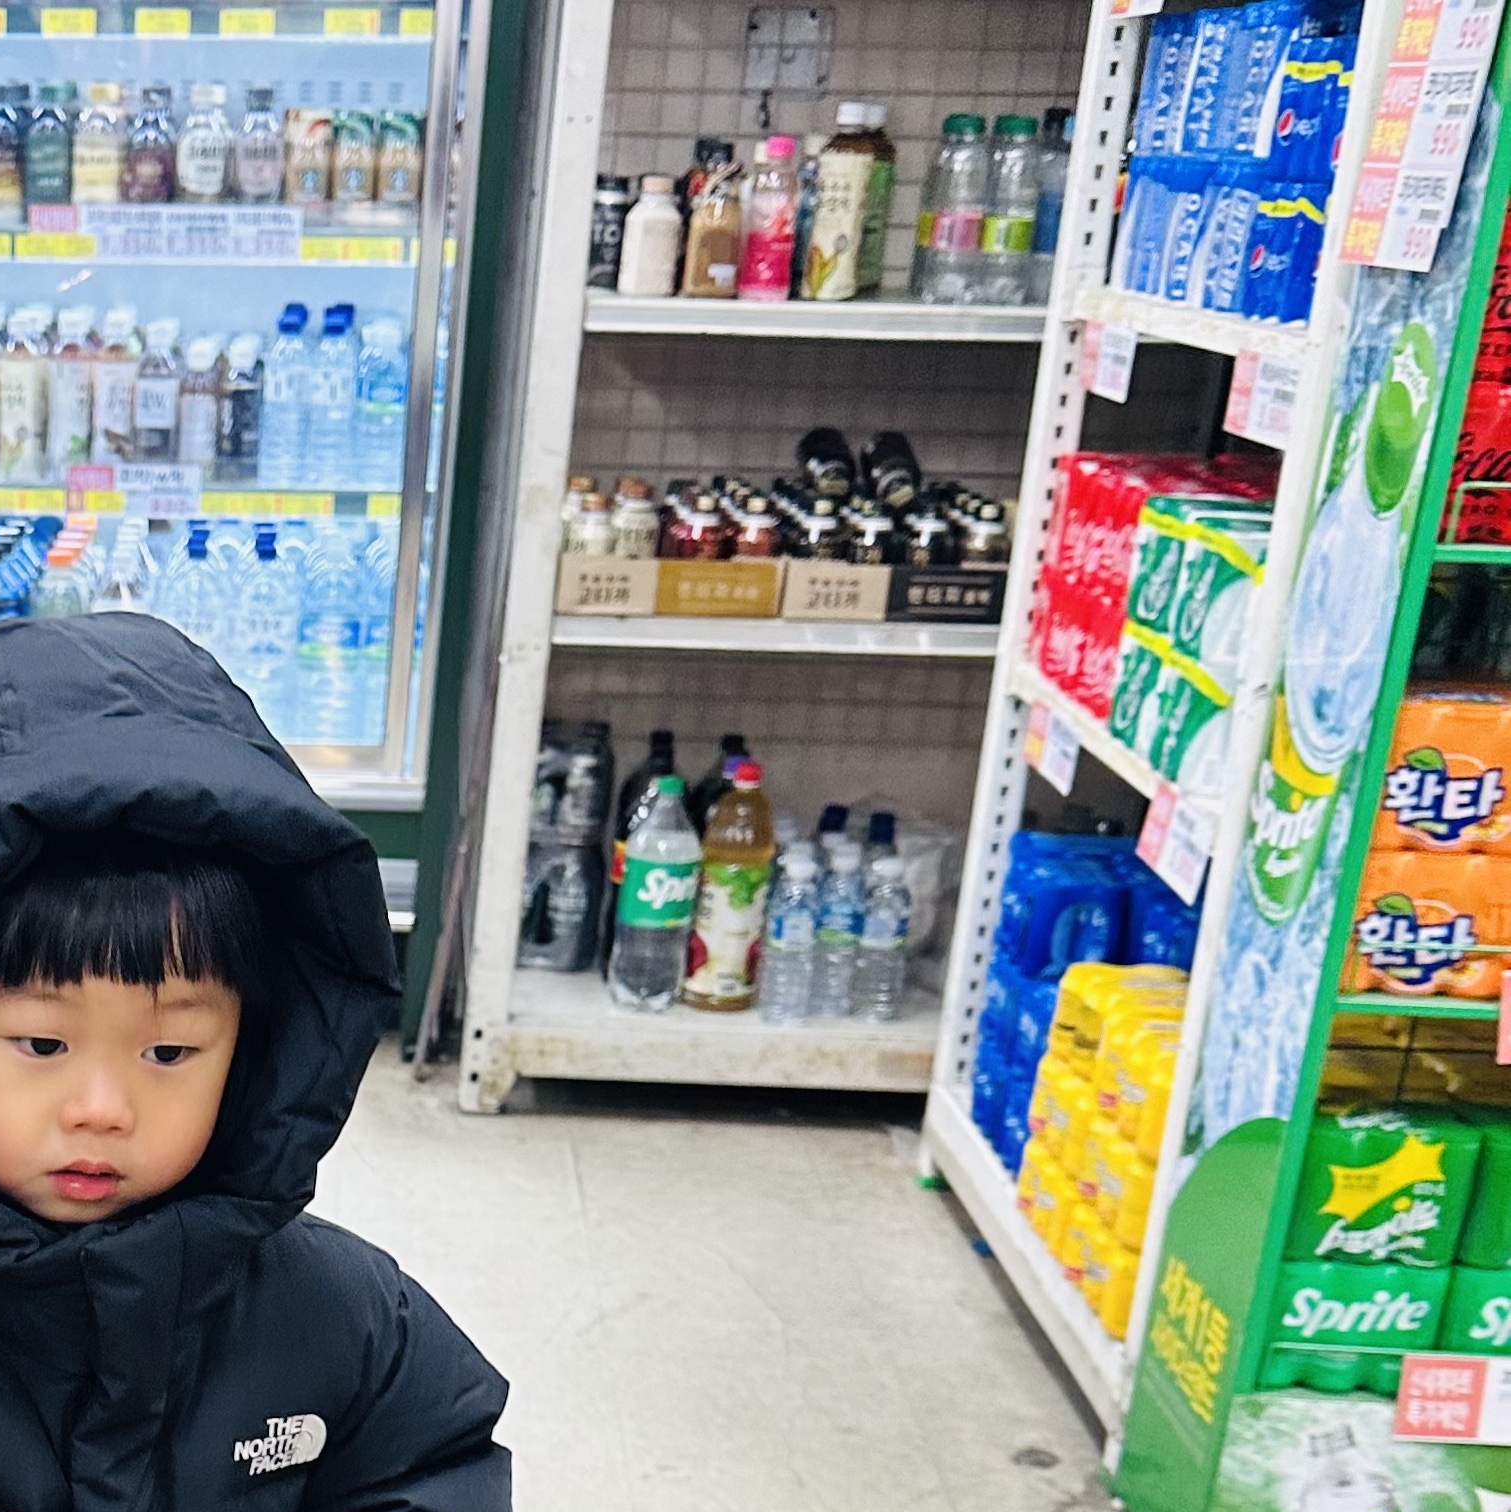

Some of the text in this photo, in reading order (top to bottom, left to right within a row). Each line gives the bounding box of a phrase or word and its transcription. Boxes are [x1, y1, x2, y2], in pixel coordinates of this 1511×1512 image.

[1384, 766, 1506, 823] 환타
[1357, 913, 1477, 967] 환타
[1282, 1287, 1431, 1339] Sprite
[266, 1415, 304, 1437] THE
[233, 1434, 298, 1461] NORTH
[248, 1450, 292, 1477] FACE
